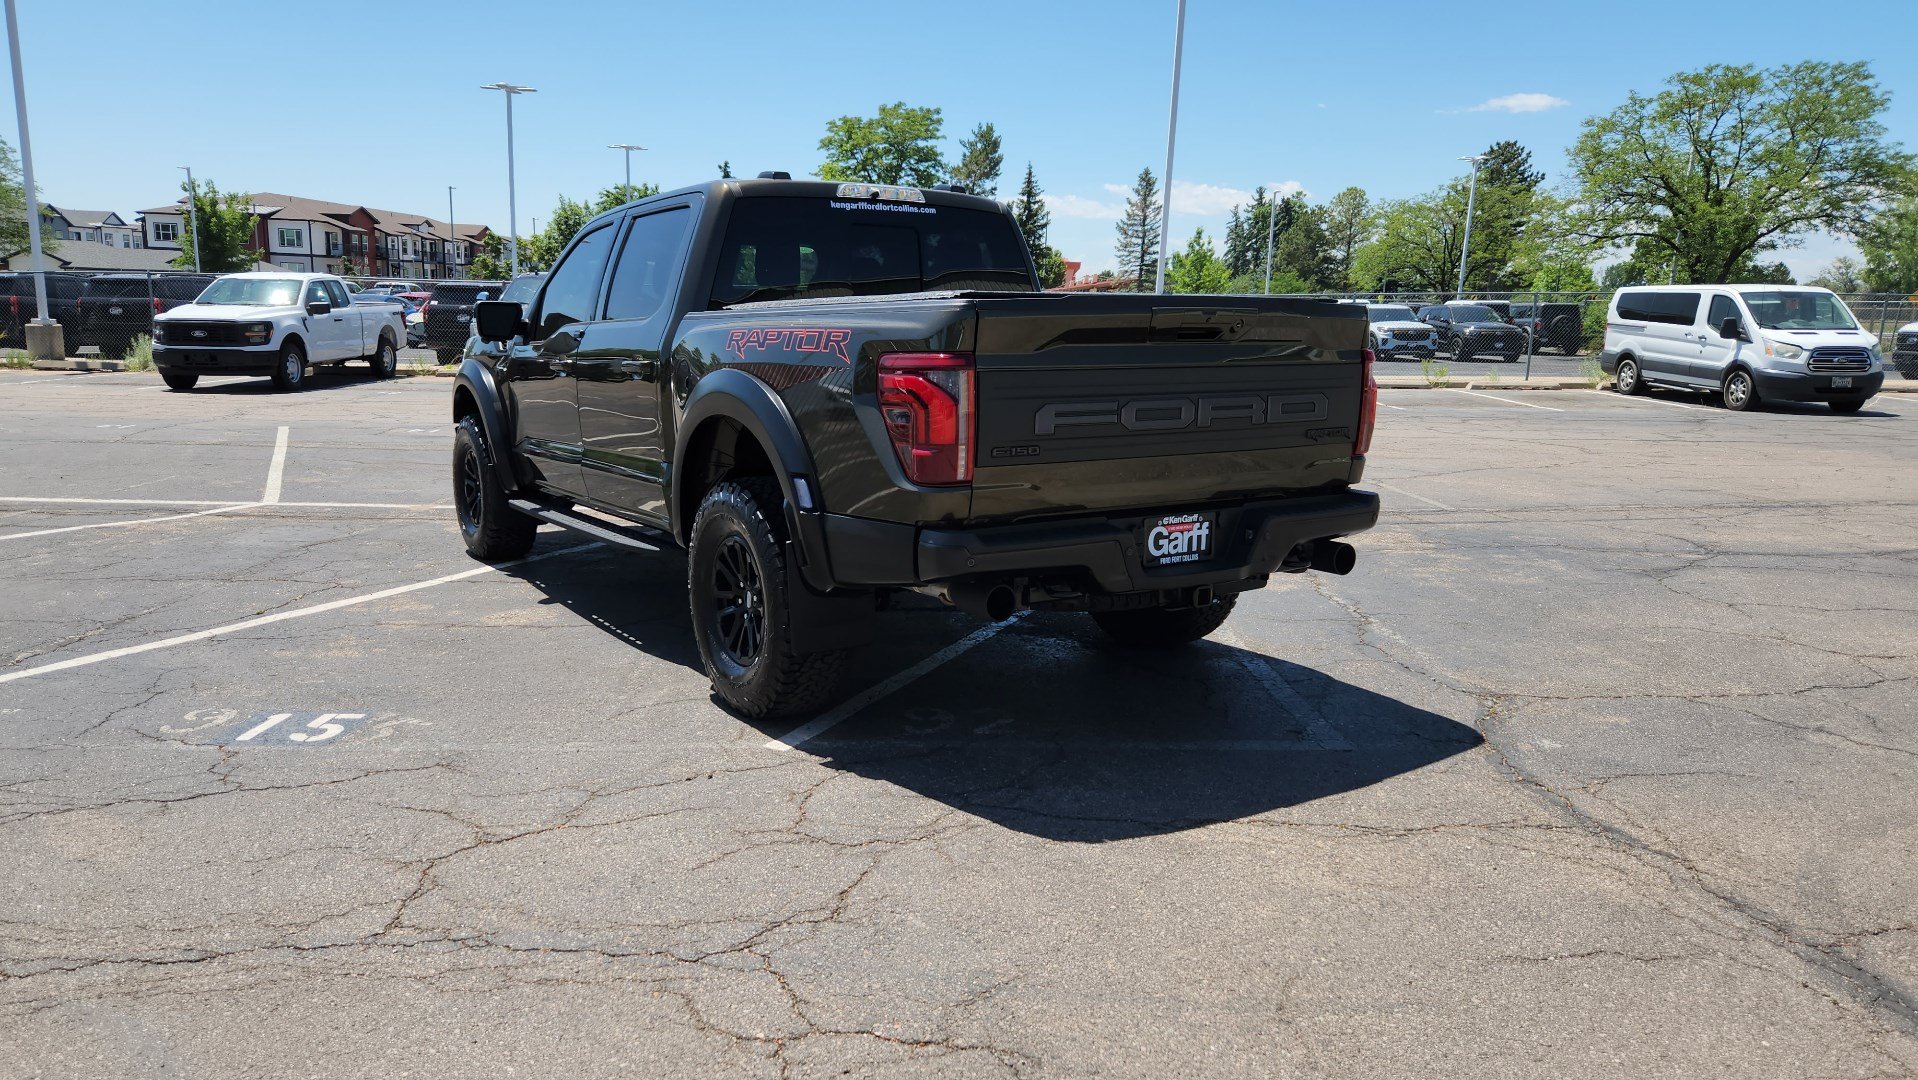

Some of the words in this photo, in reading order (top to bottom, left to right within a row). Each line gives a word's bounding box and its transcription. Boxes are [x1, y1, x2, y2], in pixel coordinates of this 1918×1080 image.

[830, 200, 937, 214] kengarfffordfortcollins.com
[725, 328, 852, 365] RAPTOR
[1034, 392, 1329, 436] FORD
[1148, 522, 1209, 557] Garff
[234, 713, 367, 742] 15
